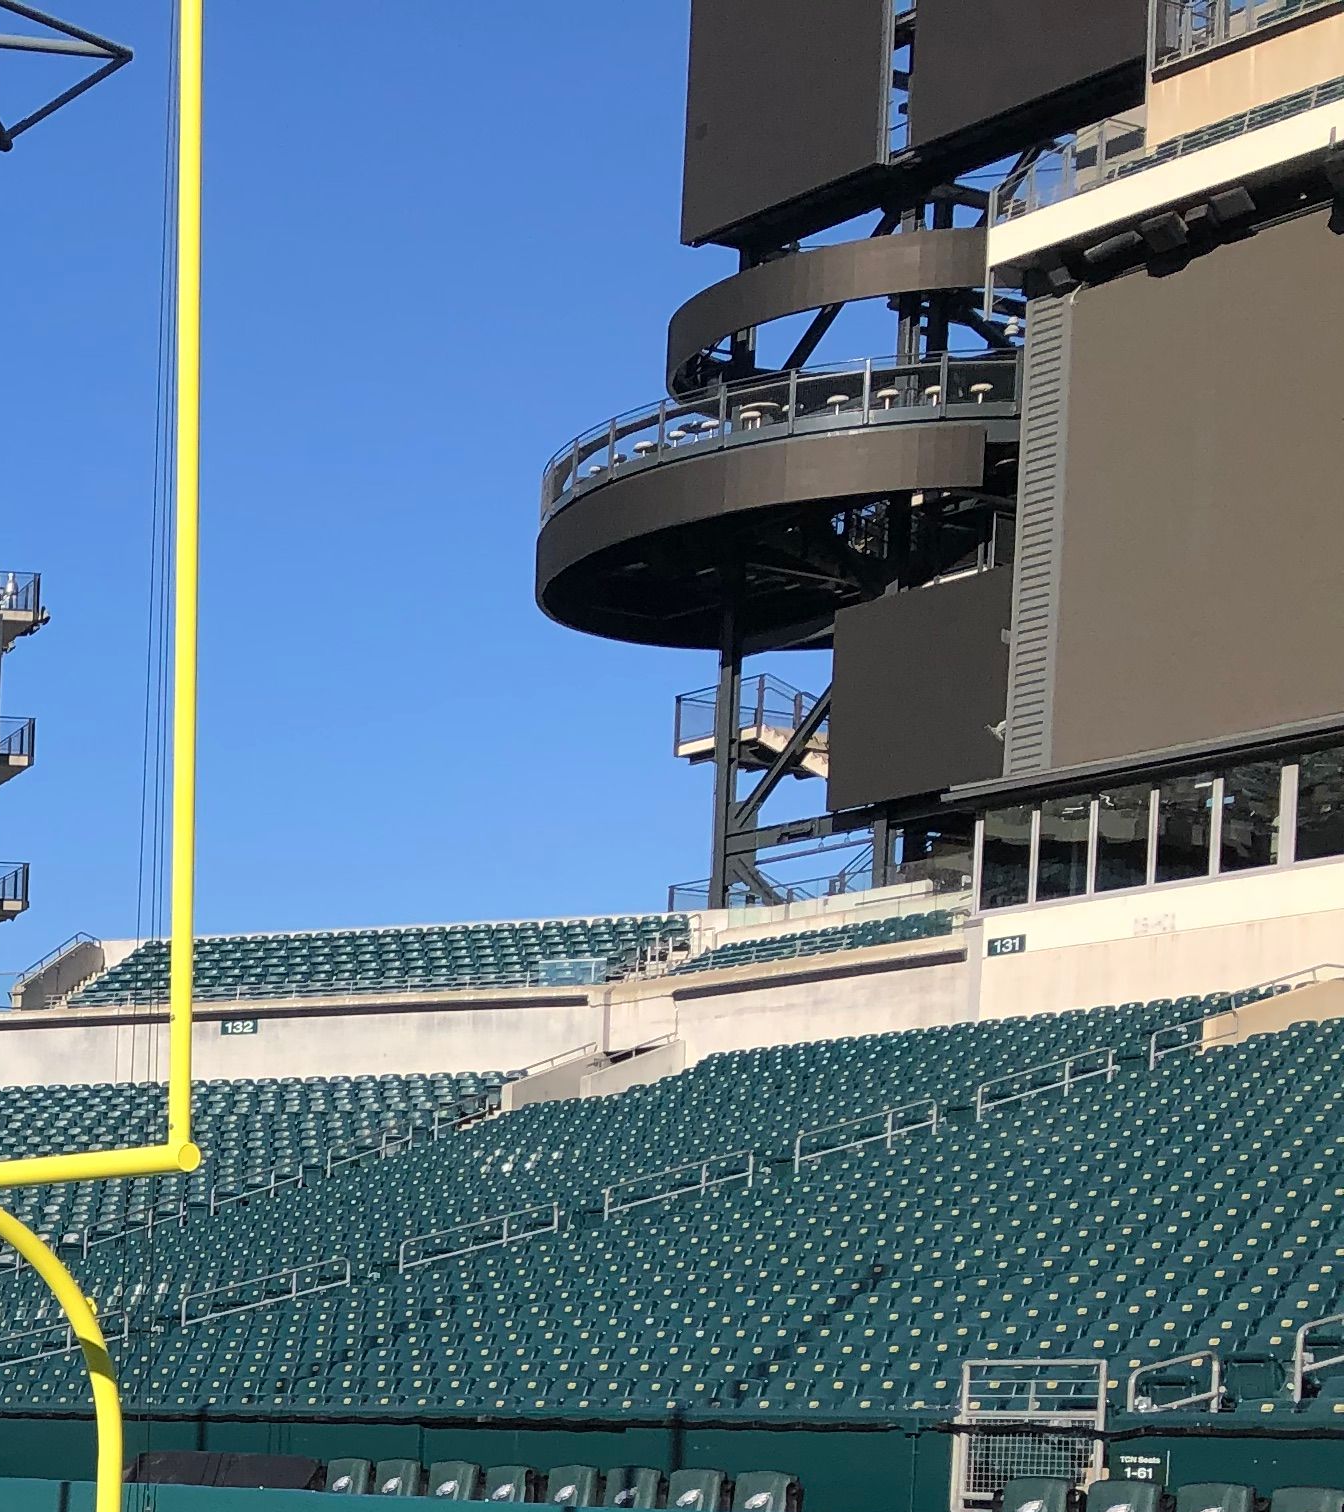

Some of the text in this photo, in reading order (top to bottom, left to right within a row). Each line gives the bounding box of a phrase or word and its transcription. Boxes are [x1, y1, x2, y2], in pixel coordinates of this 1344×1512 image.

[994, 937, 1020, 953] 131
[224, 1021, 255, 1034] 132
[1124, 1466, 1153, 1479] 1-61
